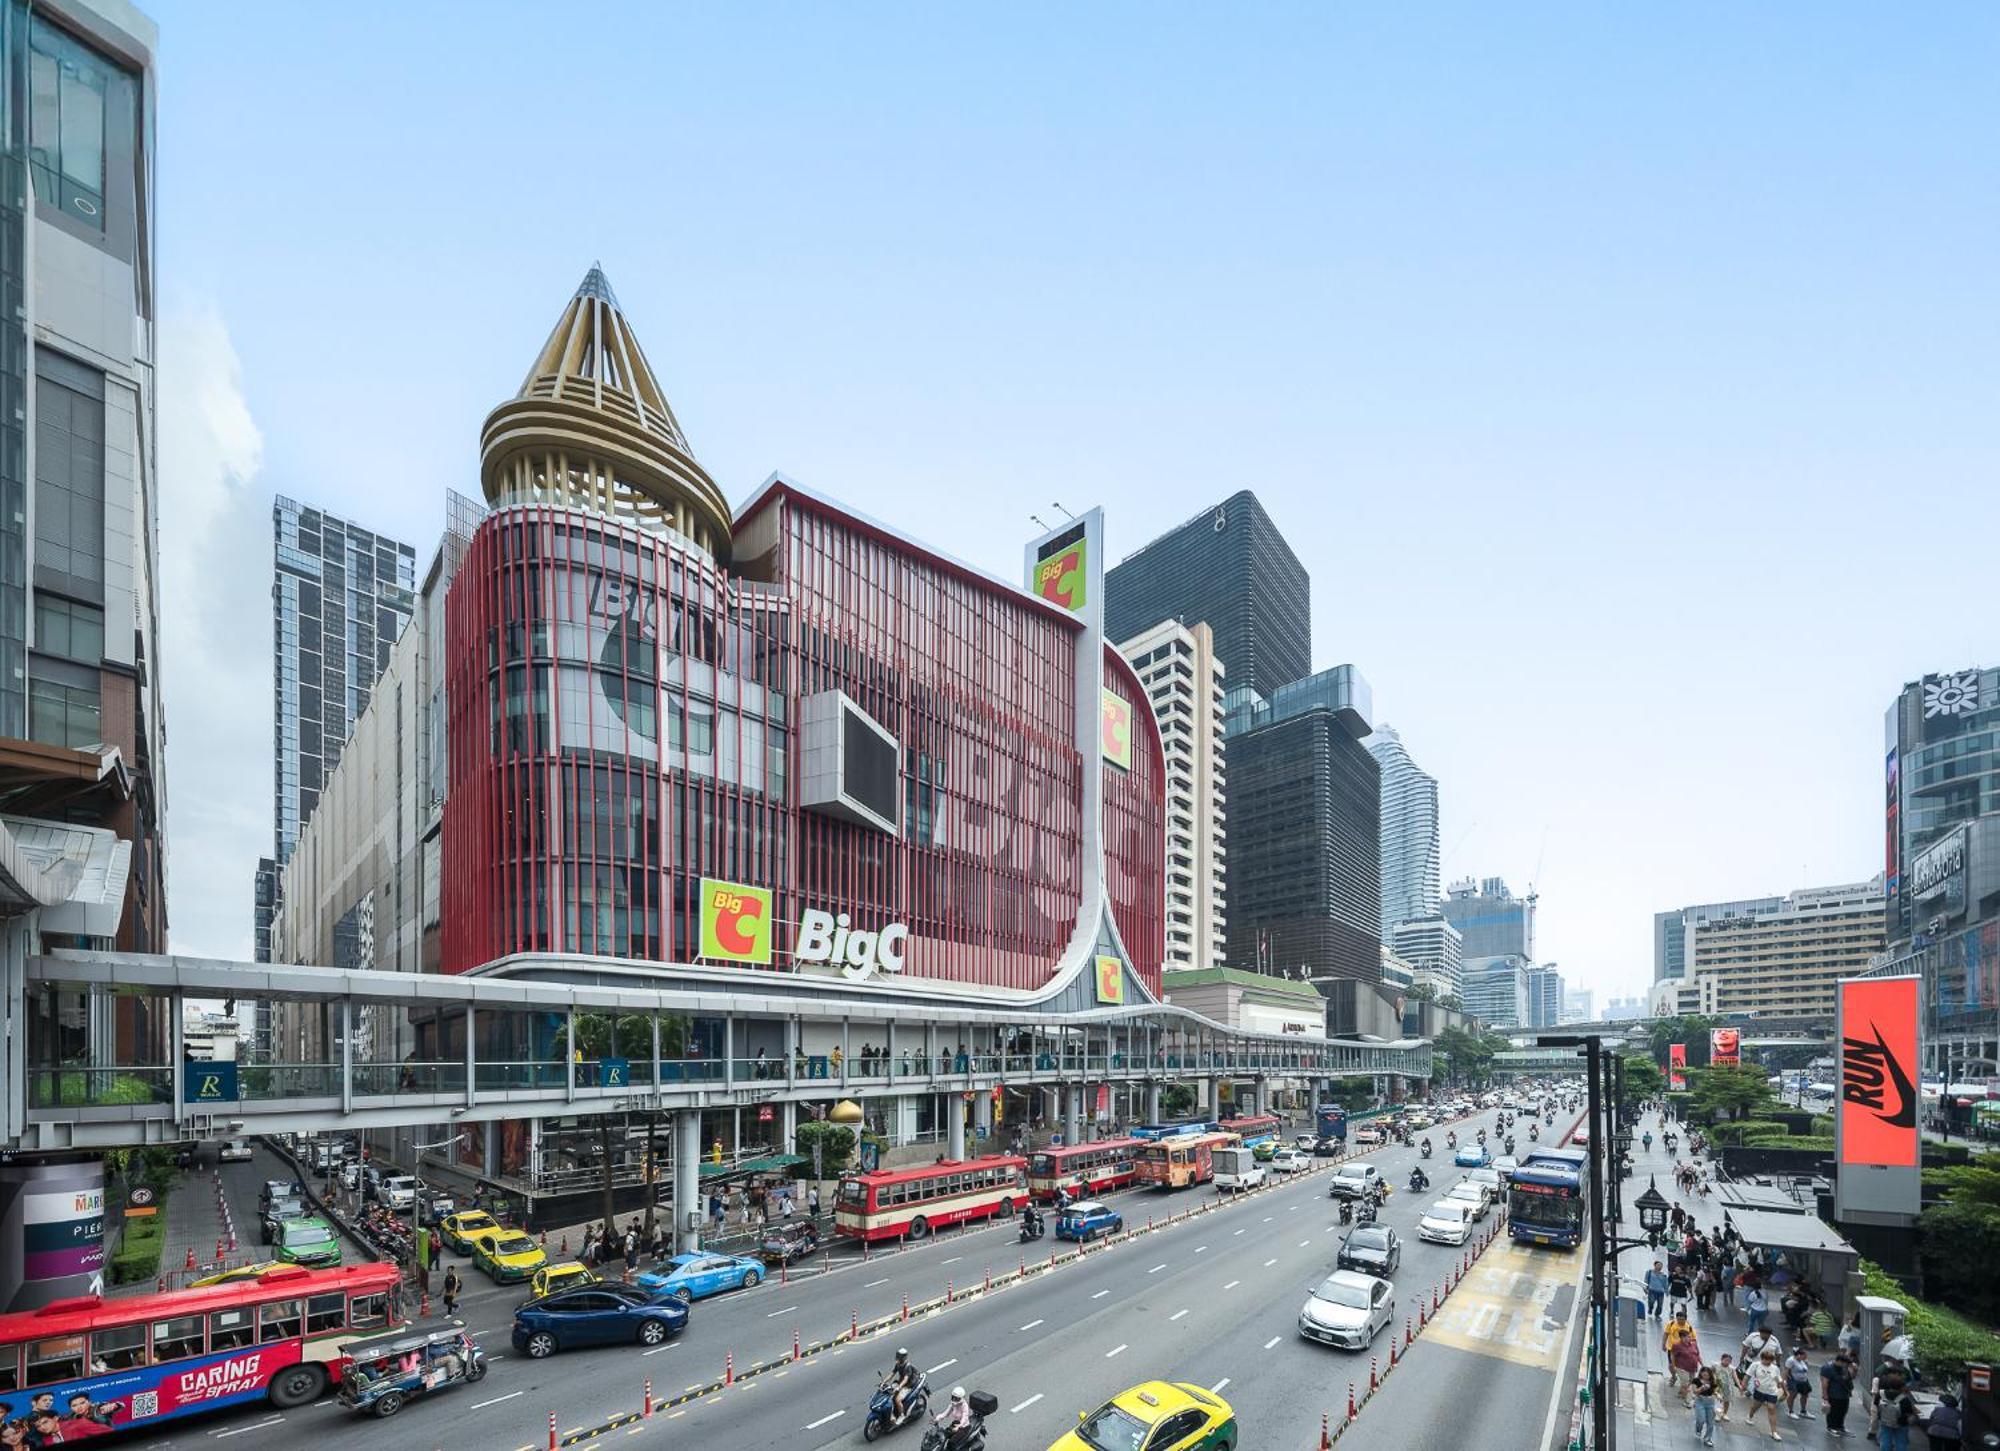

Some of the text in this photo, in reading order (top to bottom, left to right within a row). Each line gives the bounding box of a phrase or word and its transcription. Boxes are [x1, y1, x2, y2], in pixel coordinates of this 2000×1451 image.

[1040, 561, 1064, 584] Big
[1041, 550, 1079, 608] C
[714, 890, 743, 915] Big
[715, 895, 763, 955] C
[1843, 1036, 1886, 1110] RUN
[181, 1354, 261, 1392] CARING
[204, 1374, 265, 1399] SPRAY
